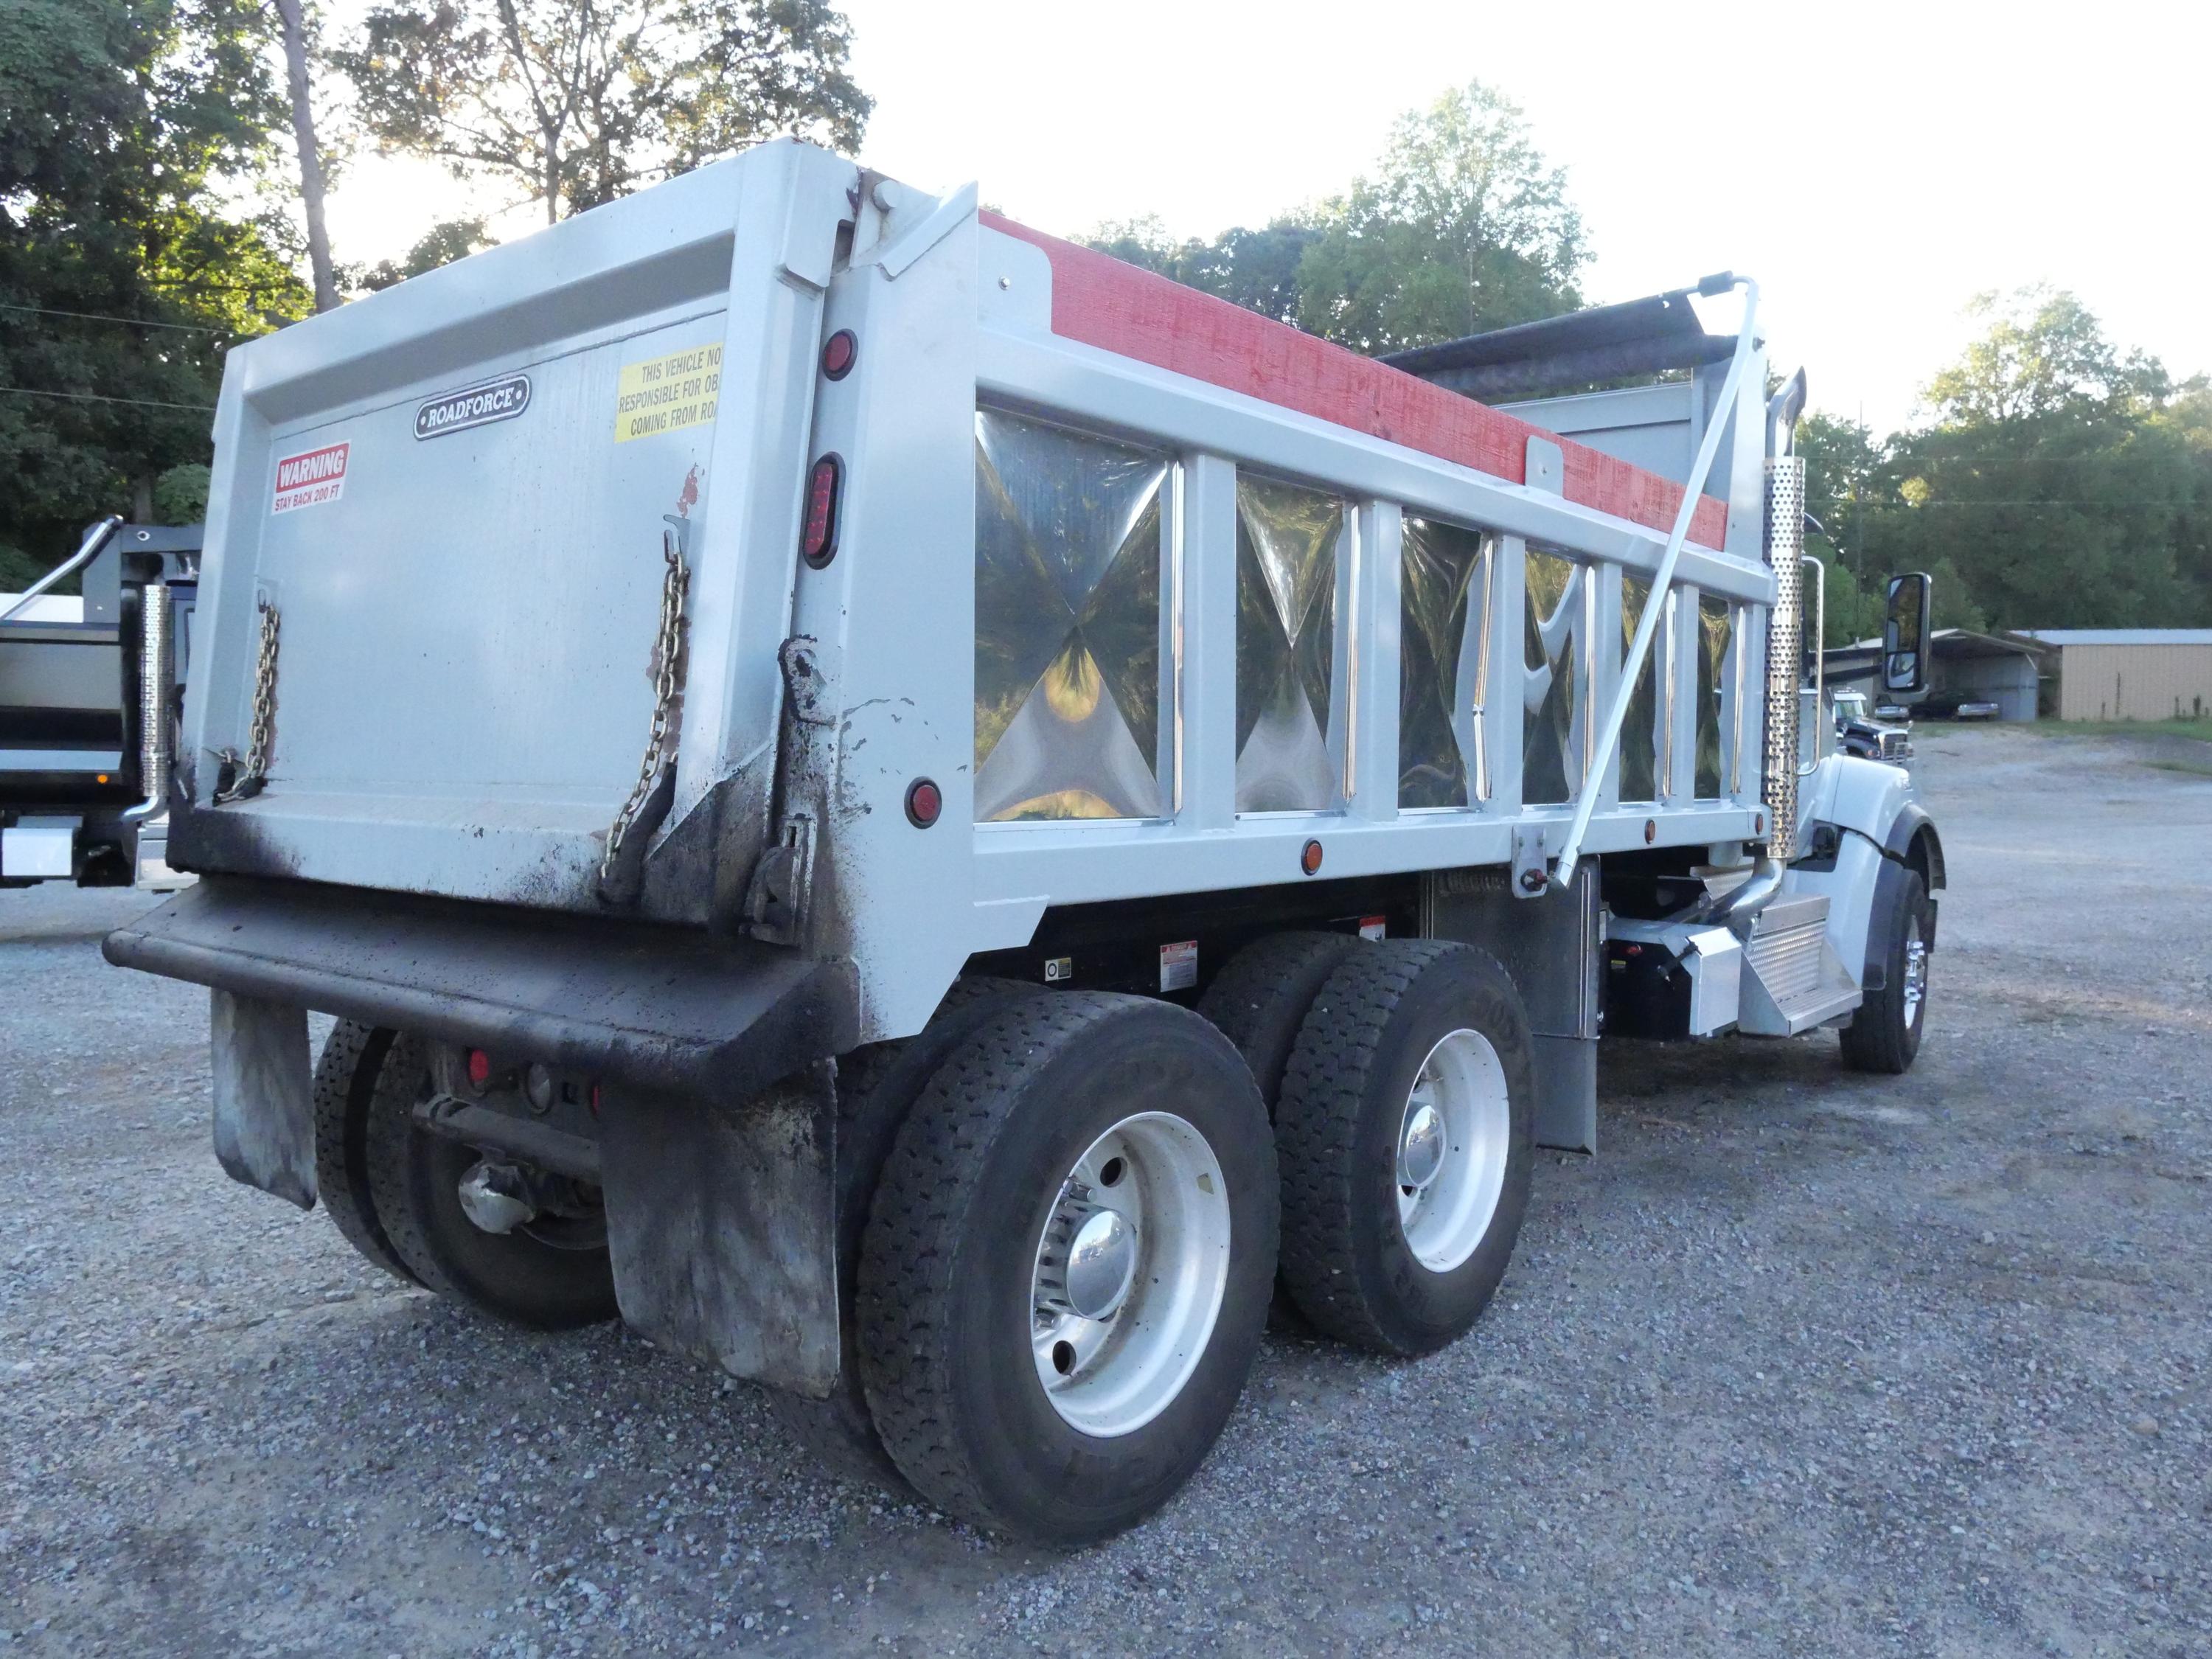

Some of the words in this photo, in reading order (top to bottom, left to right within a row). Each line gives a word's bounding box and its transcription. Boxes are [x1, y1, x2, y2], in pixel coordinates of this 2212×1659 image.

[642, 362, 662, 383] THIS
[665, 351, 704, 378] VEHICLE
[707, 347, 722, 367] NO
[427, 387, 515, 428] ROADFORCE
[619, 383, 680, 414] RESPONSIBLE
[682, 378, 701, 399] FOR
[630, 411, 667, 437] COMING
[670, 404, 698, 427] FROM
[280, 449, 344, 488] WARNING
[275, 495, 292, 512] STAY
[293, 490, 313, 507] BACK
[314, 487, 329, 502] 200
[330, 484, 340, 498] FT
